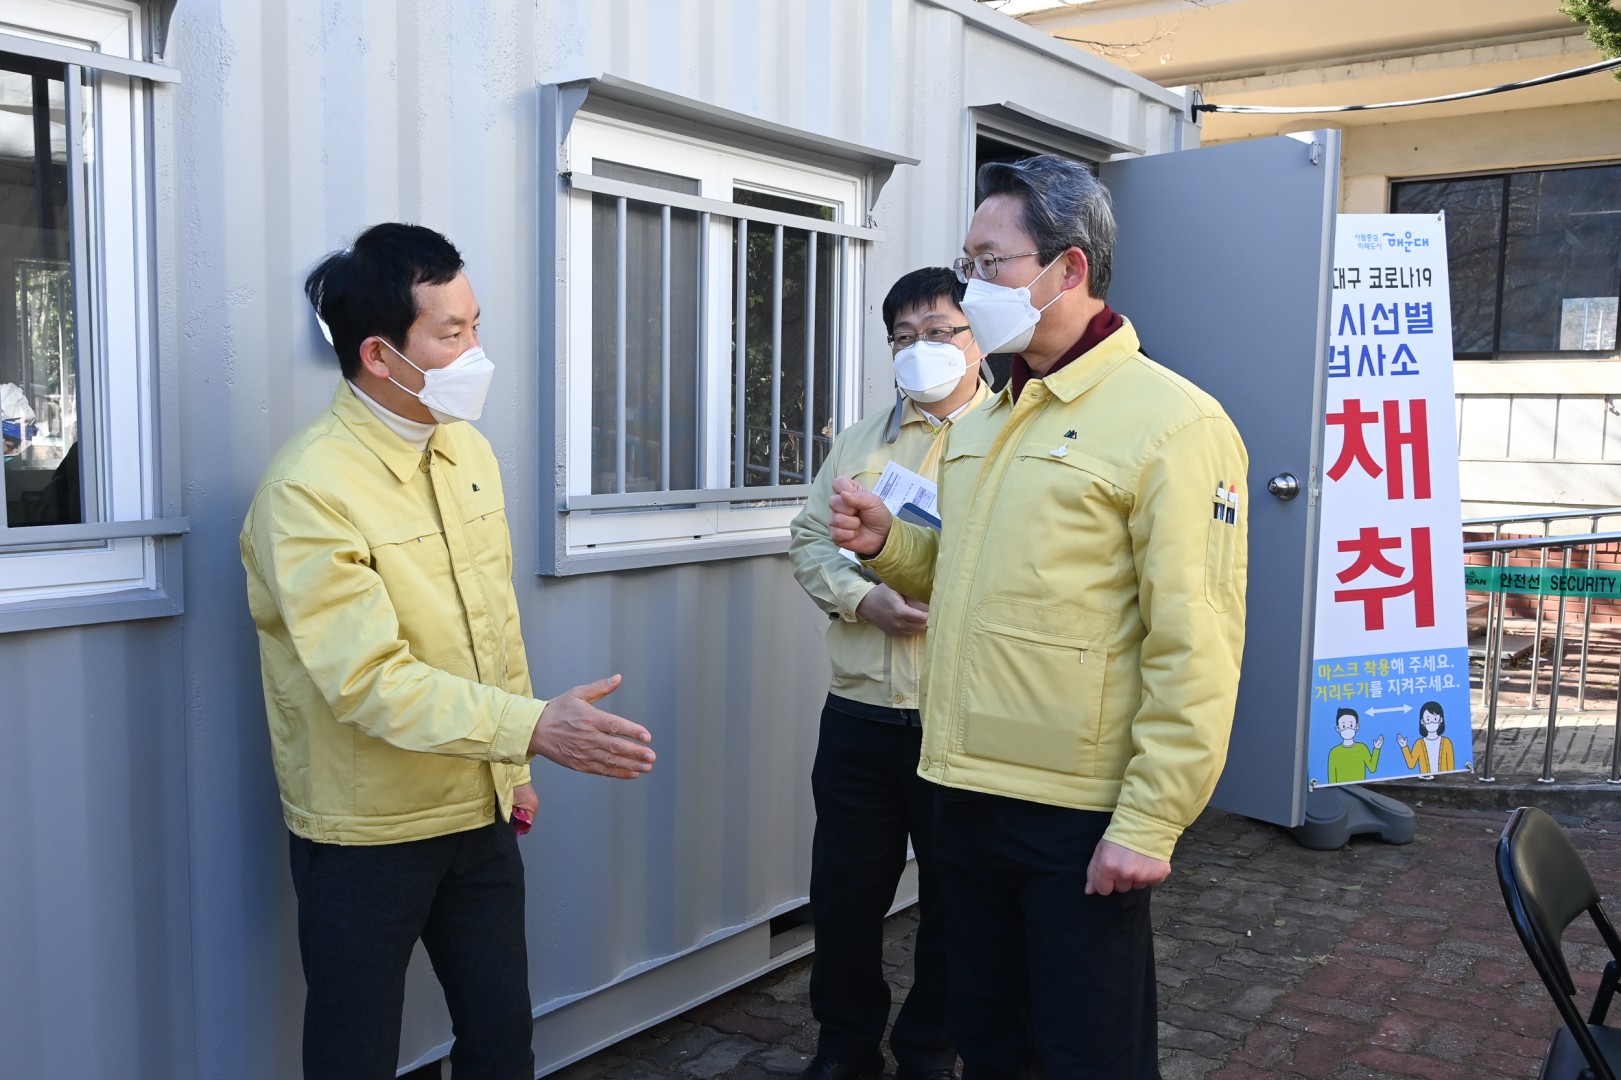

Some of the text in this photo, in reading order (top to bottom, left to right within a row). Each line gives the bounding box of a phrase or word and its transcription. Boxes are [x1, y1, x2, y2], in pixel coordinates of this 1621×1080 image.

[1382, 231, 1429, 253] 해운대
[1369, 267, 1432, 289] 코로나19
[1330, 302, 1433, 336] 시선별
[1500, 573, 1540, 589] 안전선
[1550, 575, 1616, 592] SECURITY
[1318, 654, 1455, 681] 마스크 착용해 주세요.
[1315, 674, 1460, 702] 거리두기를 지켜주세요.
